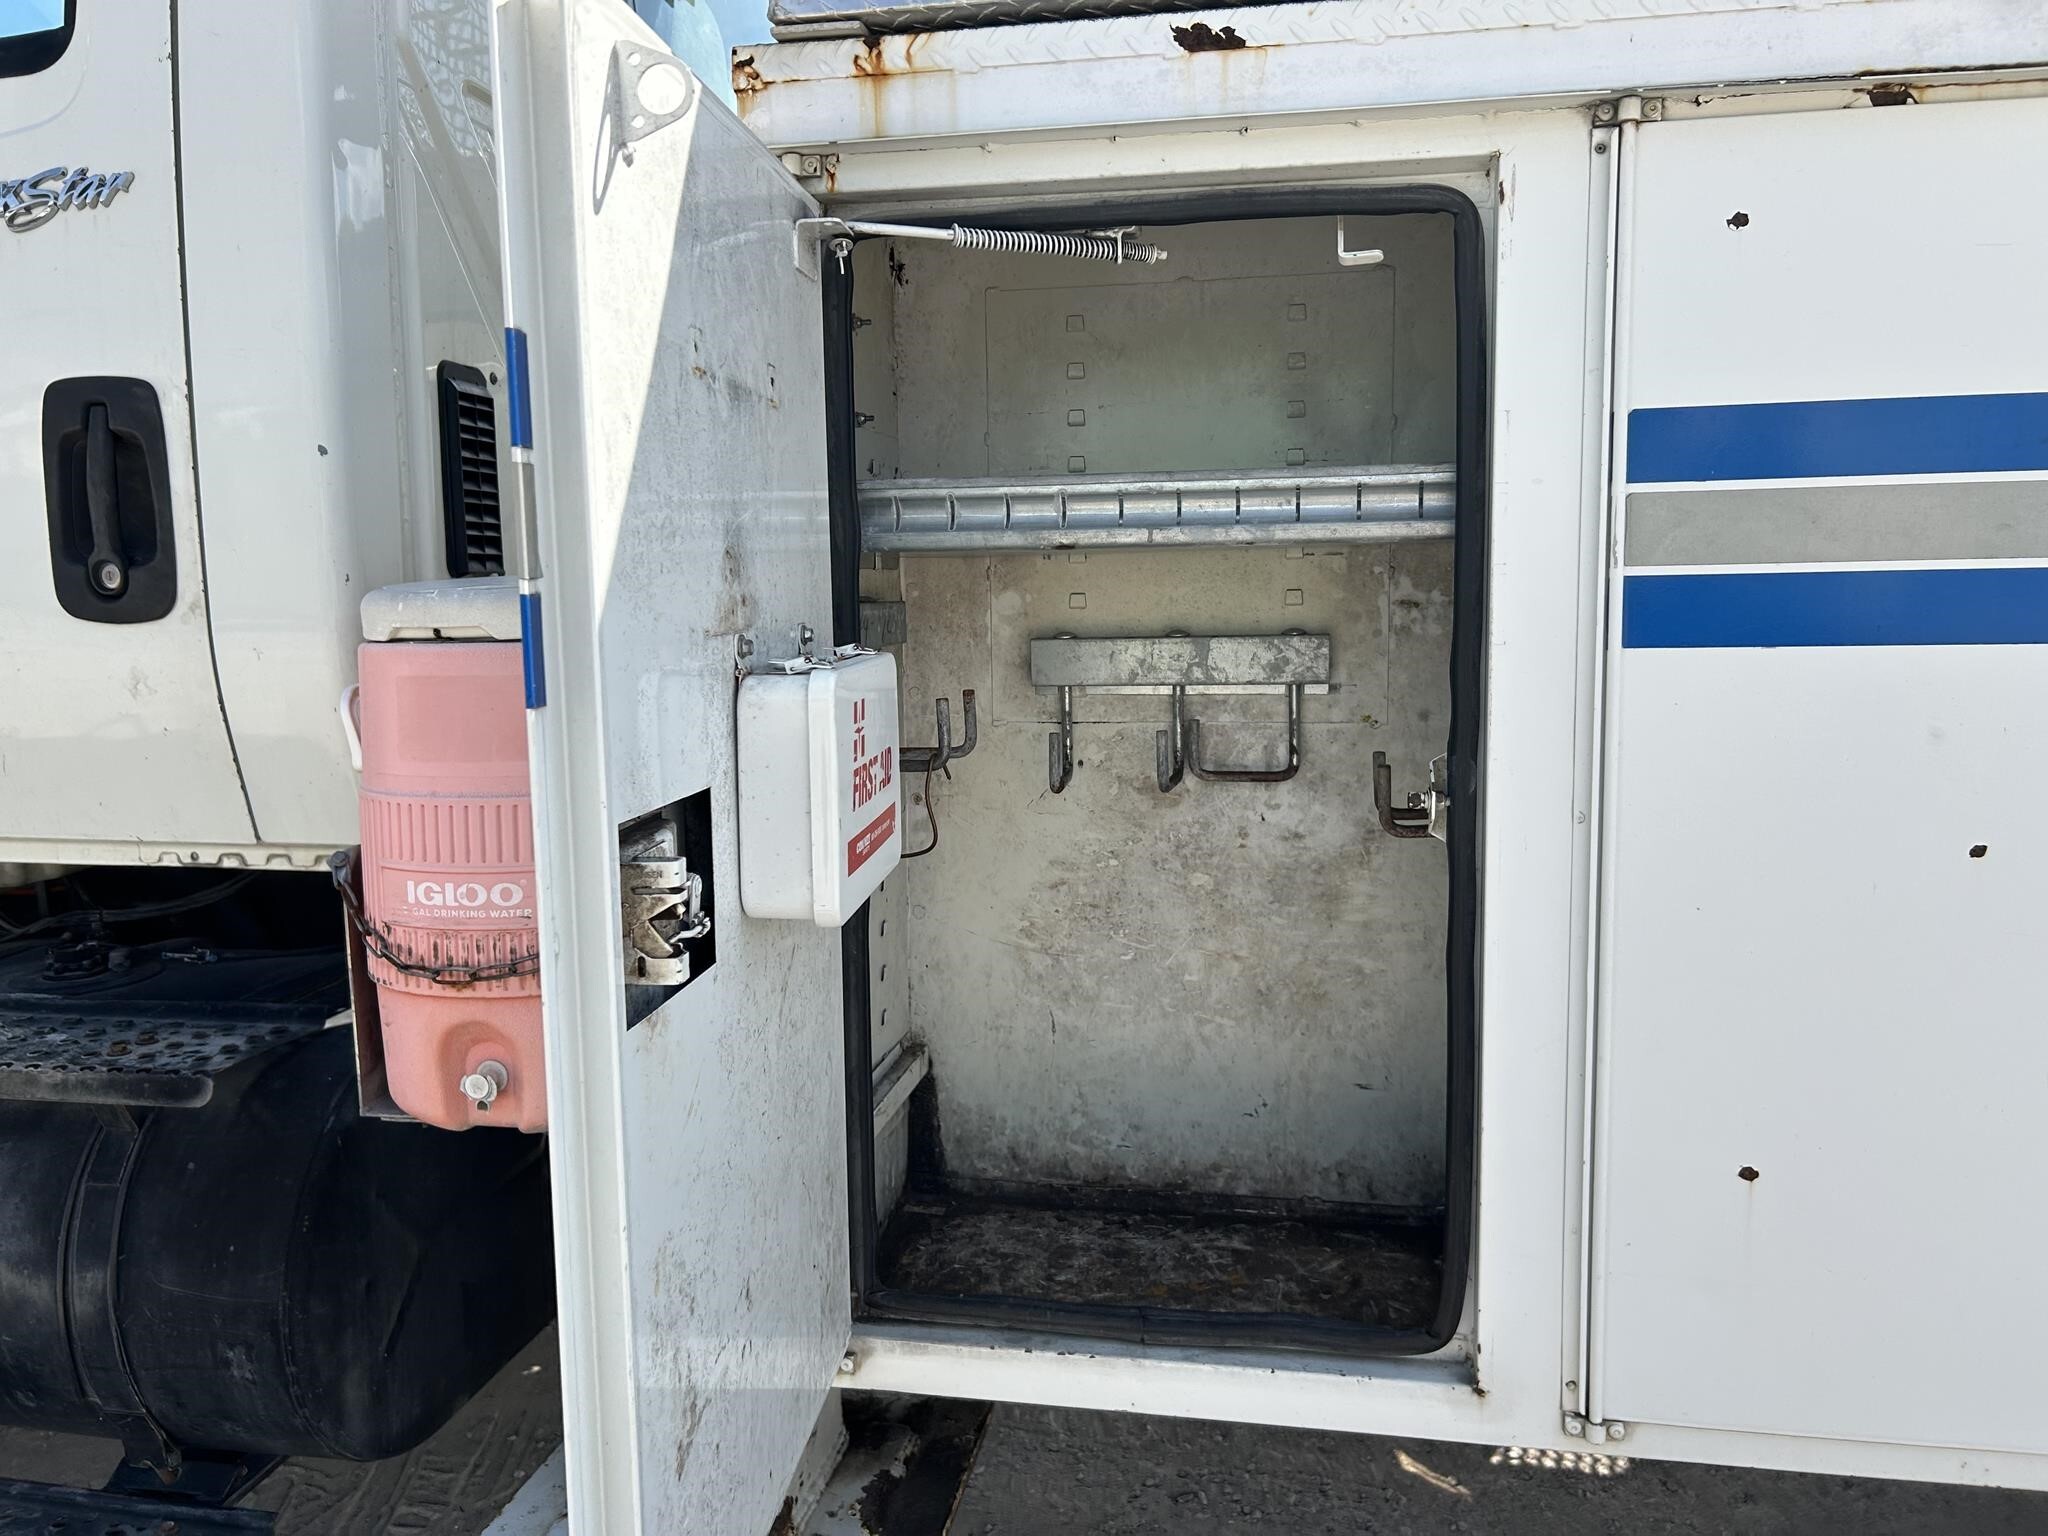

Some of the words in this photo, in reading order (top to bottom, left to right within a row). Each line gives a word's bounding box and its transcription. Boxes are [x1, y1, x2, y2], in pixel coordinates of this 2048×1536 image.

[853, 755, 878, 812] FIRST
[879, 746, 892, 791] AID
[406, 880, 523, 907] IGLOO
[413, 907, 431, 916] GAL
[434, 909, 486, 918] DRINKING
[490, 908, 532, 918] WATER
